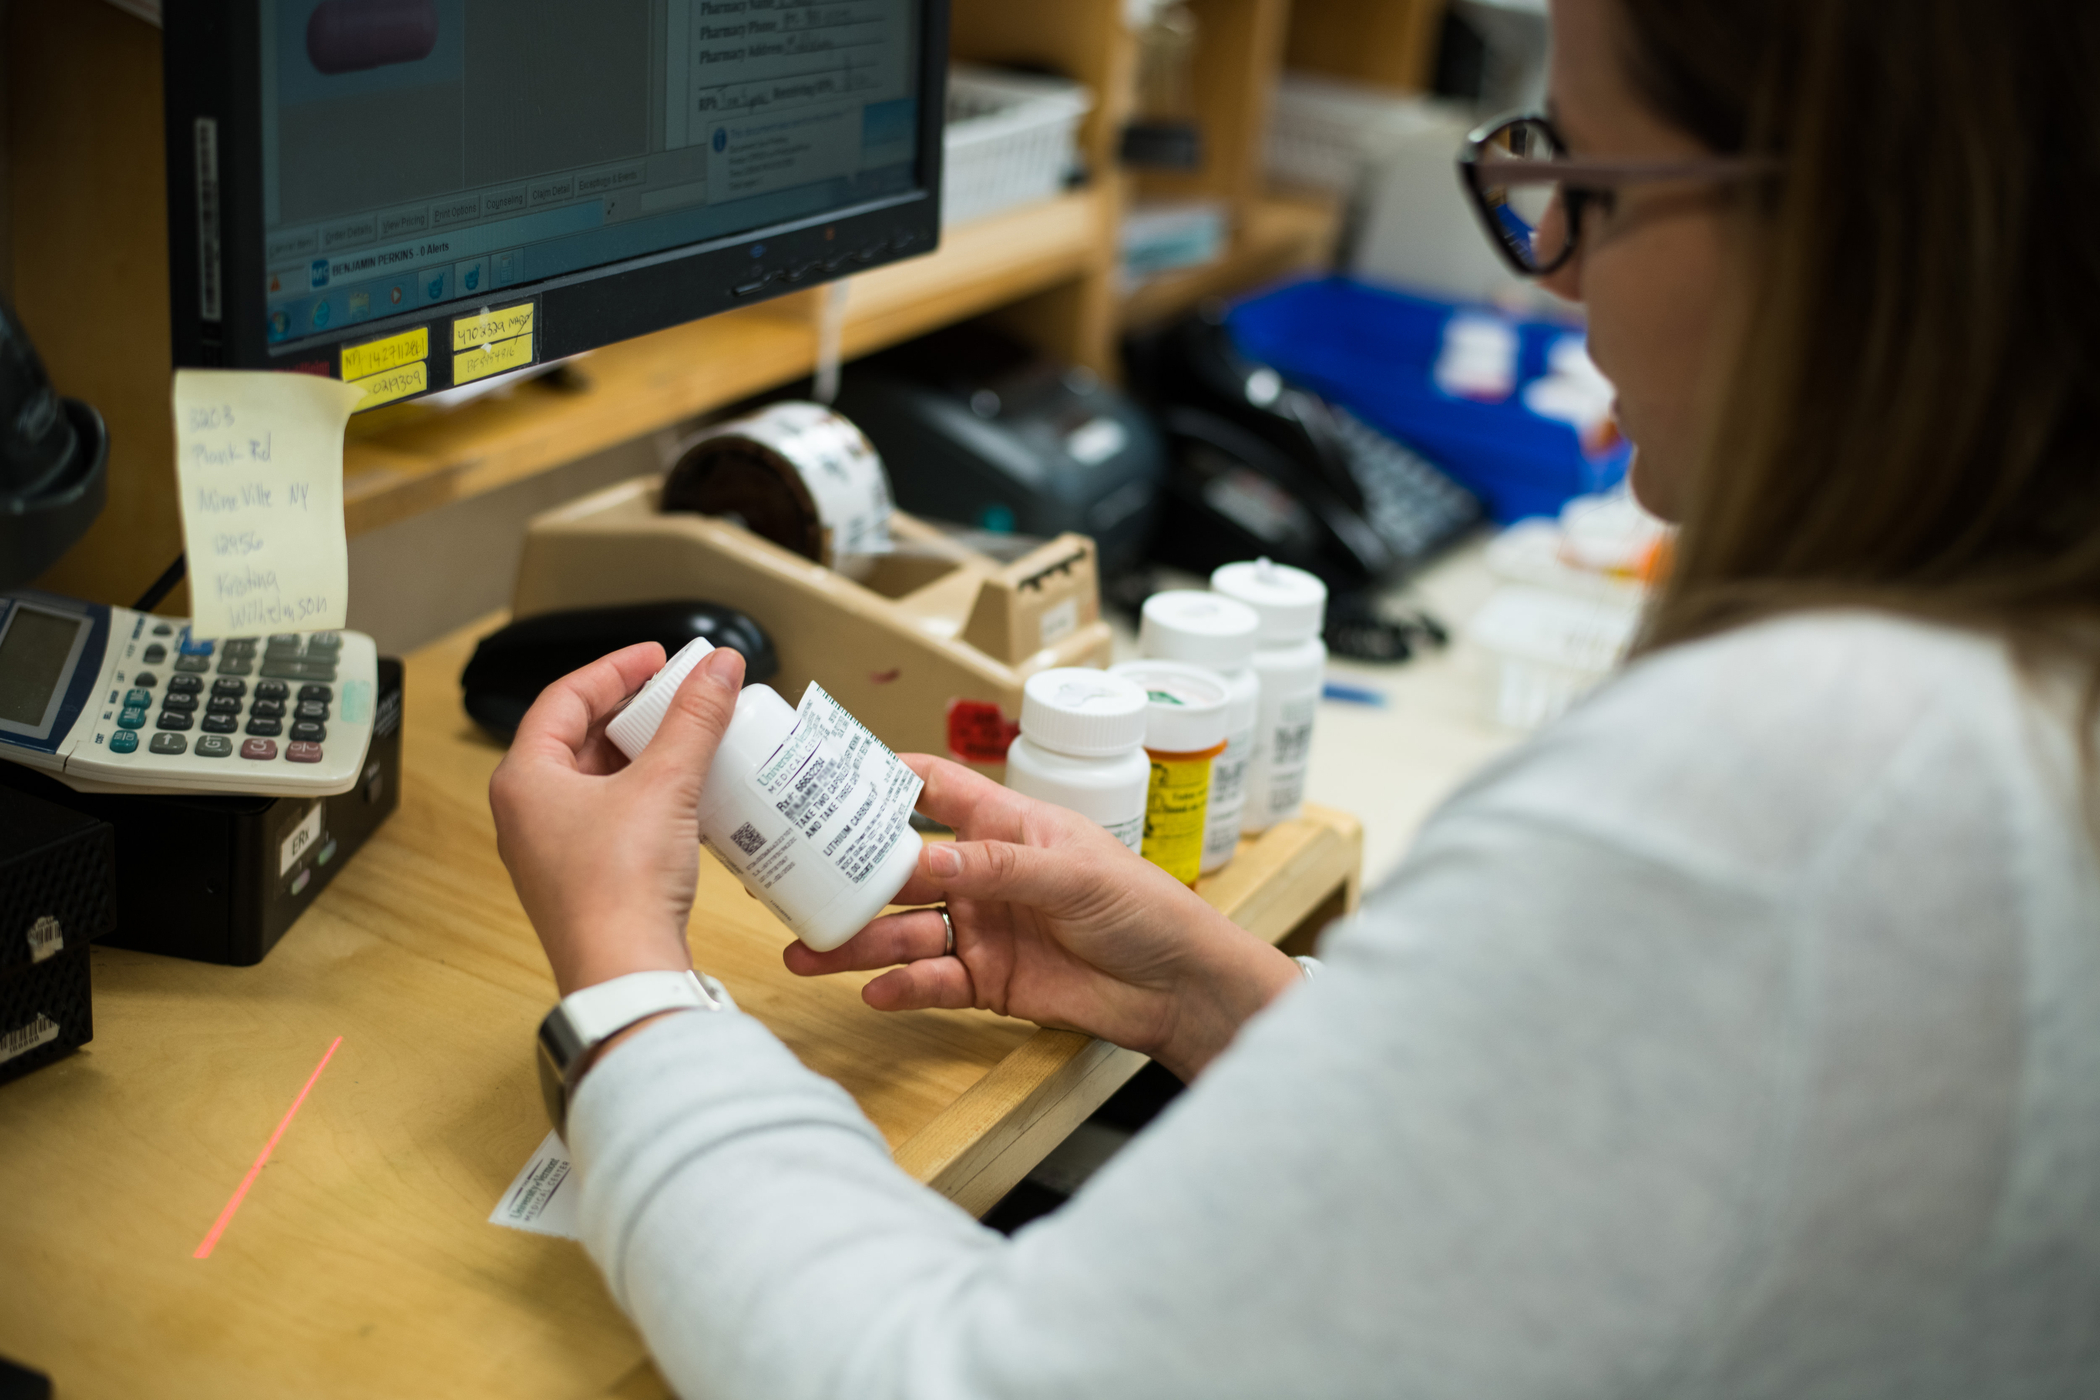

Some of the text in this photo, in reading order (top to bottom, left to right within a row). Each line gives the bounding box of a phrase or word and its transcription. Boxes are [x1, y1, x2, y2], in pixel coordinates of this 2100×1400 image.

[484, 192, 524, 211] Counseling
[531, 182, 571, 200] Claim Detail
[381, 212, 426, 233] View Pricing
[433, 202, 477, 222] Print Options
[331, 256, 376, 276] BENJAMIN
[376, 248, 414, 266] PERKINS
[425, 241, 449, 254] Alerts
[289, 482, 309, 511] NY
[163, 711, 185, 720] 7
[209, 714, 231, 723] 4
[205, 735, 222, 748] GT
[250, 738, 268, 751] CA
[756, 744, 797, 787] University
[767, 752, 805, 794] MEDICAL
[775, 790, 798, 812] Rx#:
[795, 808, 816, 829] TAKE
[812, 791, 830, 810] TWO
[804, 820, 822, 839] AND
[819, 800, 839, 822] TAKE
[834, 782, 854, 804] THREE
[291, 827, 311, 857] ERx
[822, 824, 853, 856] LITHIUM
[524, 1160, 569, 1221] MEDICAL CENTER
